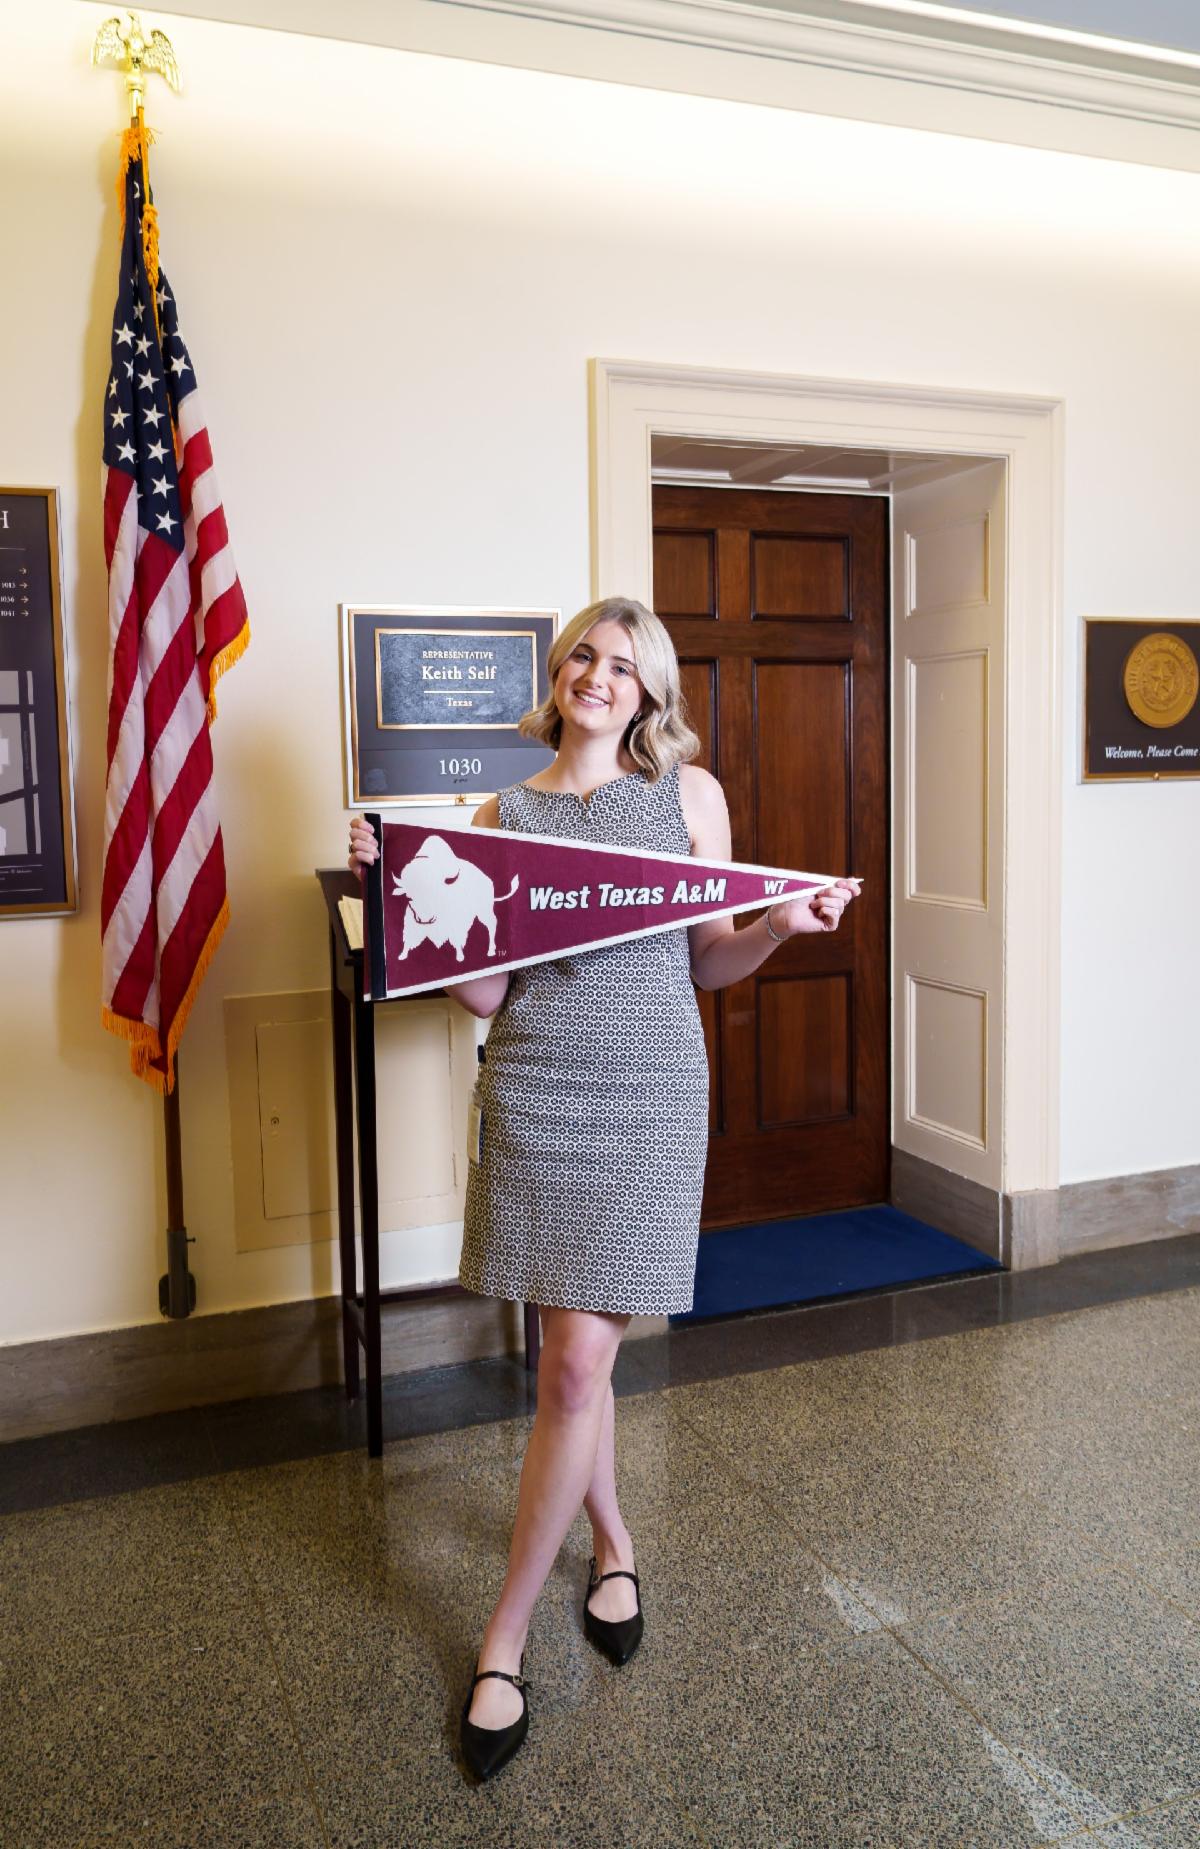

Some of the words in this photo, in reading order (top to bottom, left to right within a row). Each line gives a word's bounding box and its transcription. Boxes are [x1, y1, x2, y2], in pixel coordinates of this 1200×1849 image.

[422, 651, 494, 660] REPRESENTATIVE
[422, 666, 463, 680] Keith
[468, 666, 497, 680] Self
[446, 697, 473, 707] Texas
[1105, 746, 1144, 759] Welcome,
[1146, 745, 1172, 757] Please
[1174, 745, 1199, 757] Come
[439, 758, 482, 776] 1030
[529, 885, 590, 911] West
[598, 882, 664, 908] Texas
[671, 878, 726, 904] A&M
[764, 880, 789, 896] WT
